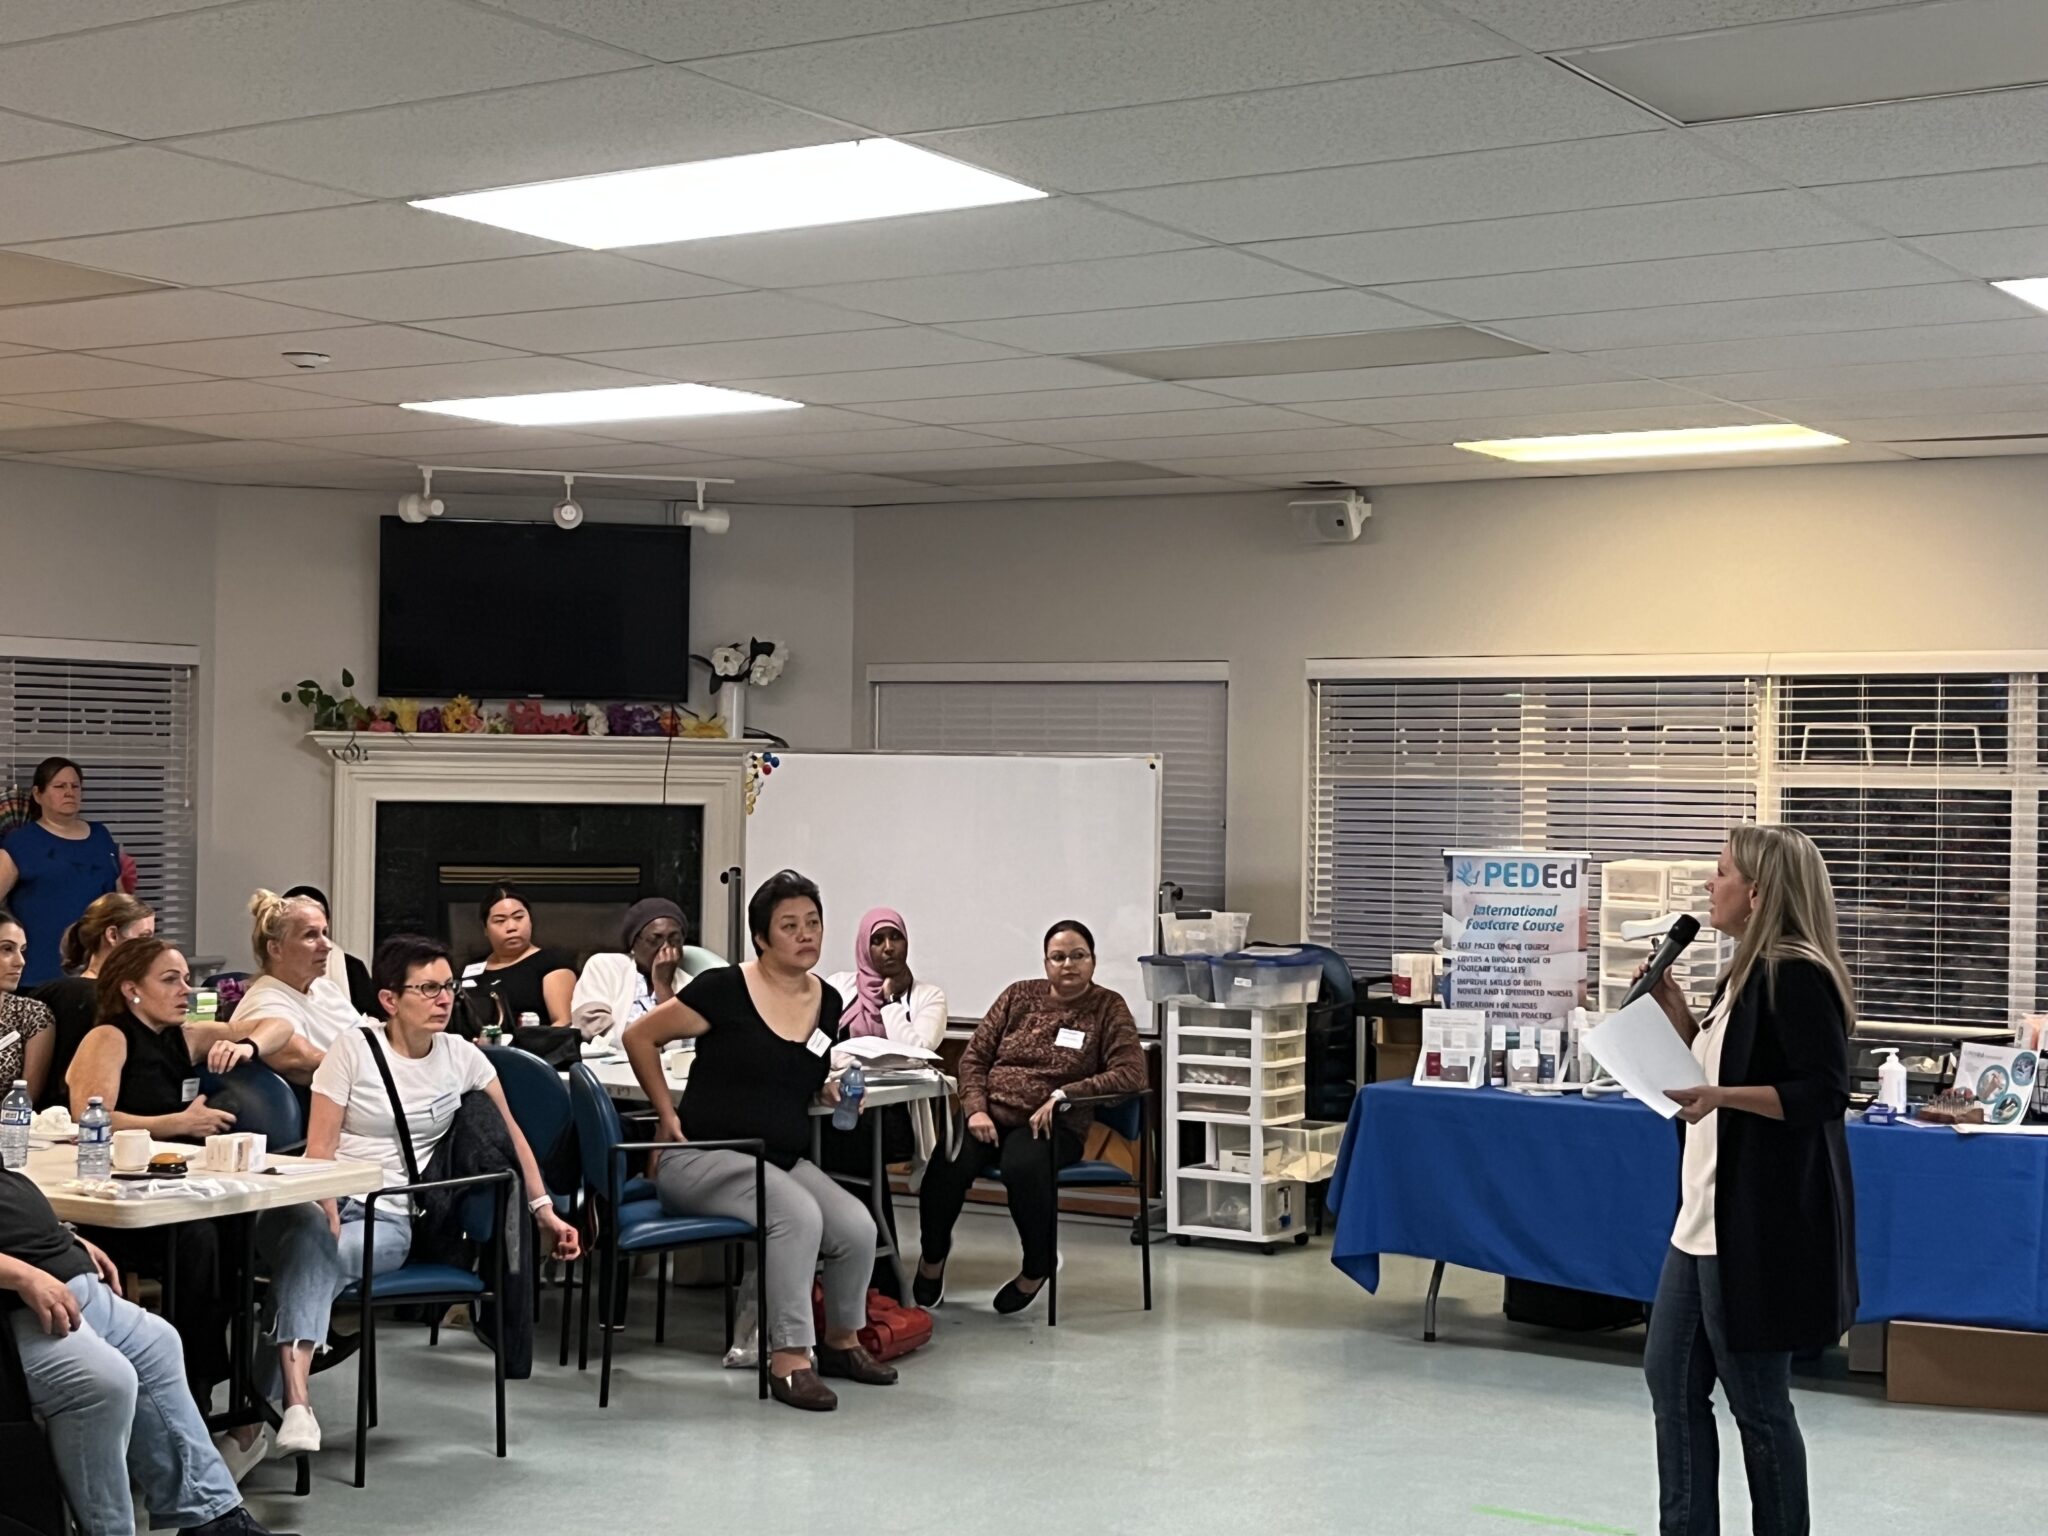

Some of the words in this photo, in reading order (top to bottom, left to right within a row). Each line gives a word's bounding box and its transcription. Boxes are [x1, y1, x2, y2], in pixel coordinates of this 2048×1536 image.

[1484, 862, 1577, 888] PEDEd
[1473, 904, 1558, 916] International
[1466, 918, 1519, 931] Footcare
[1522, 920, 1564, 932] Course
